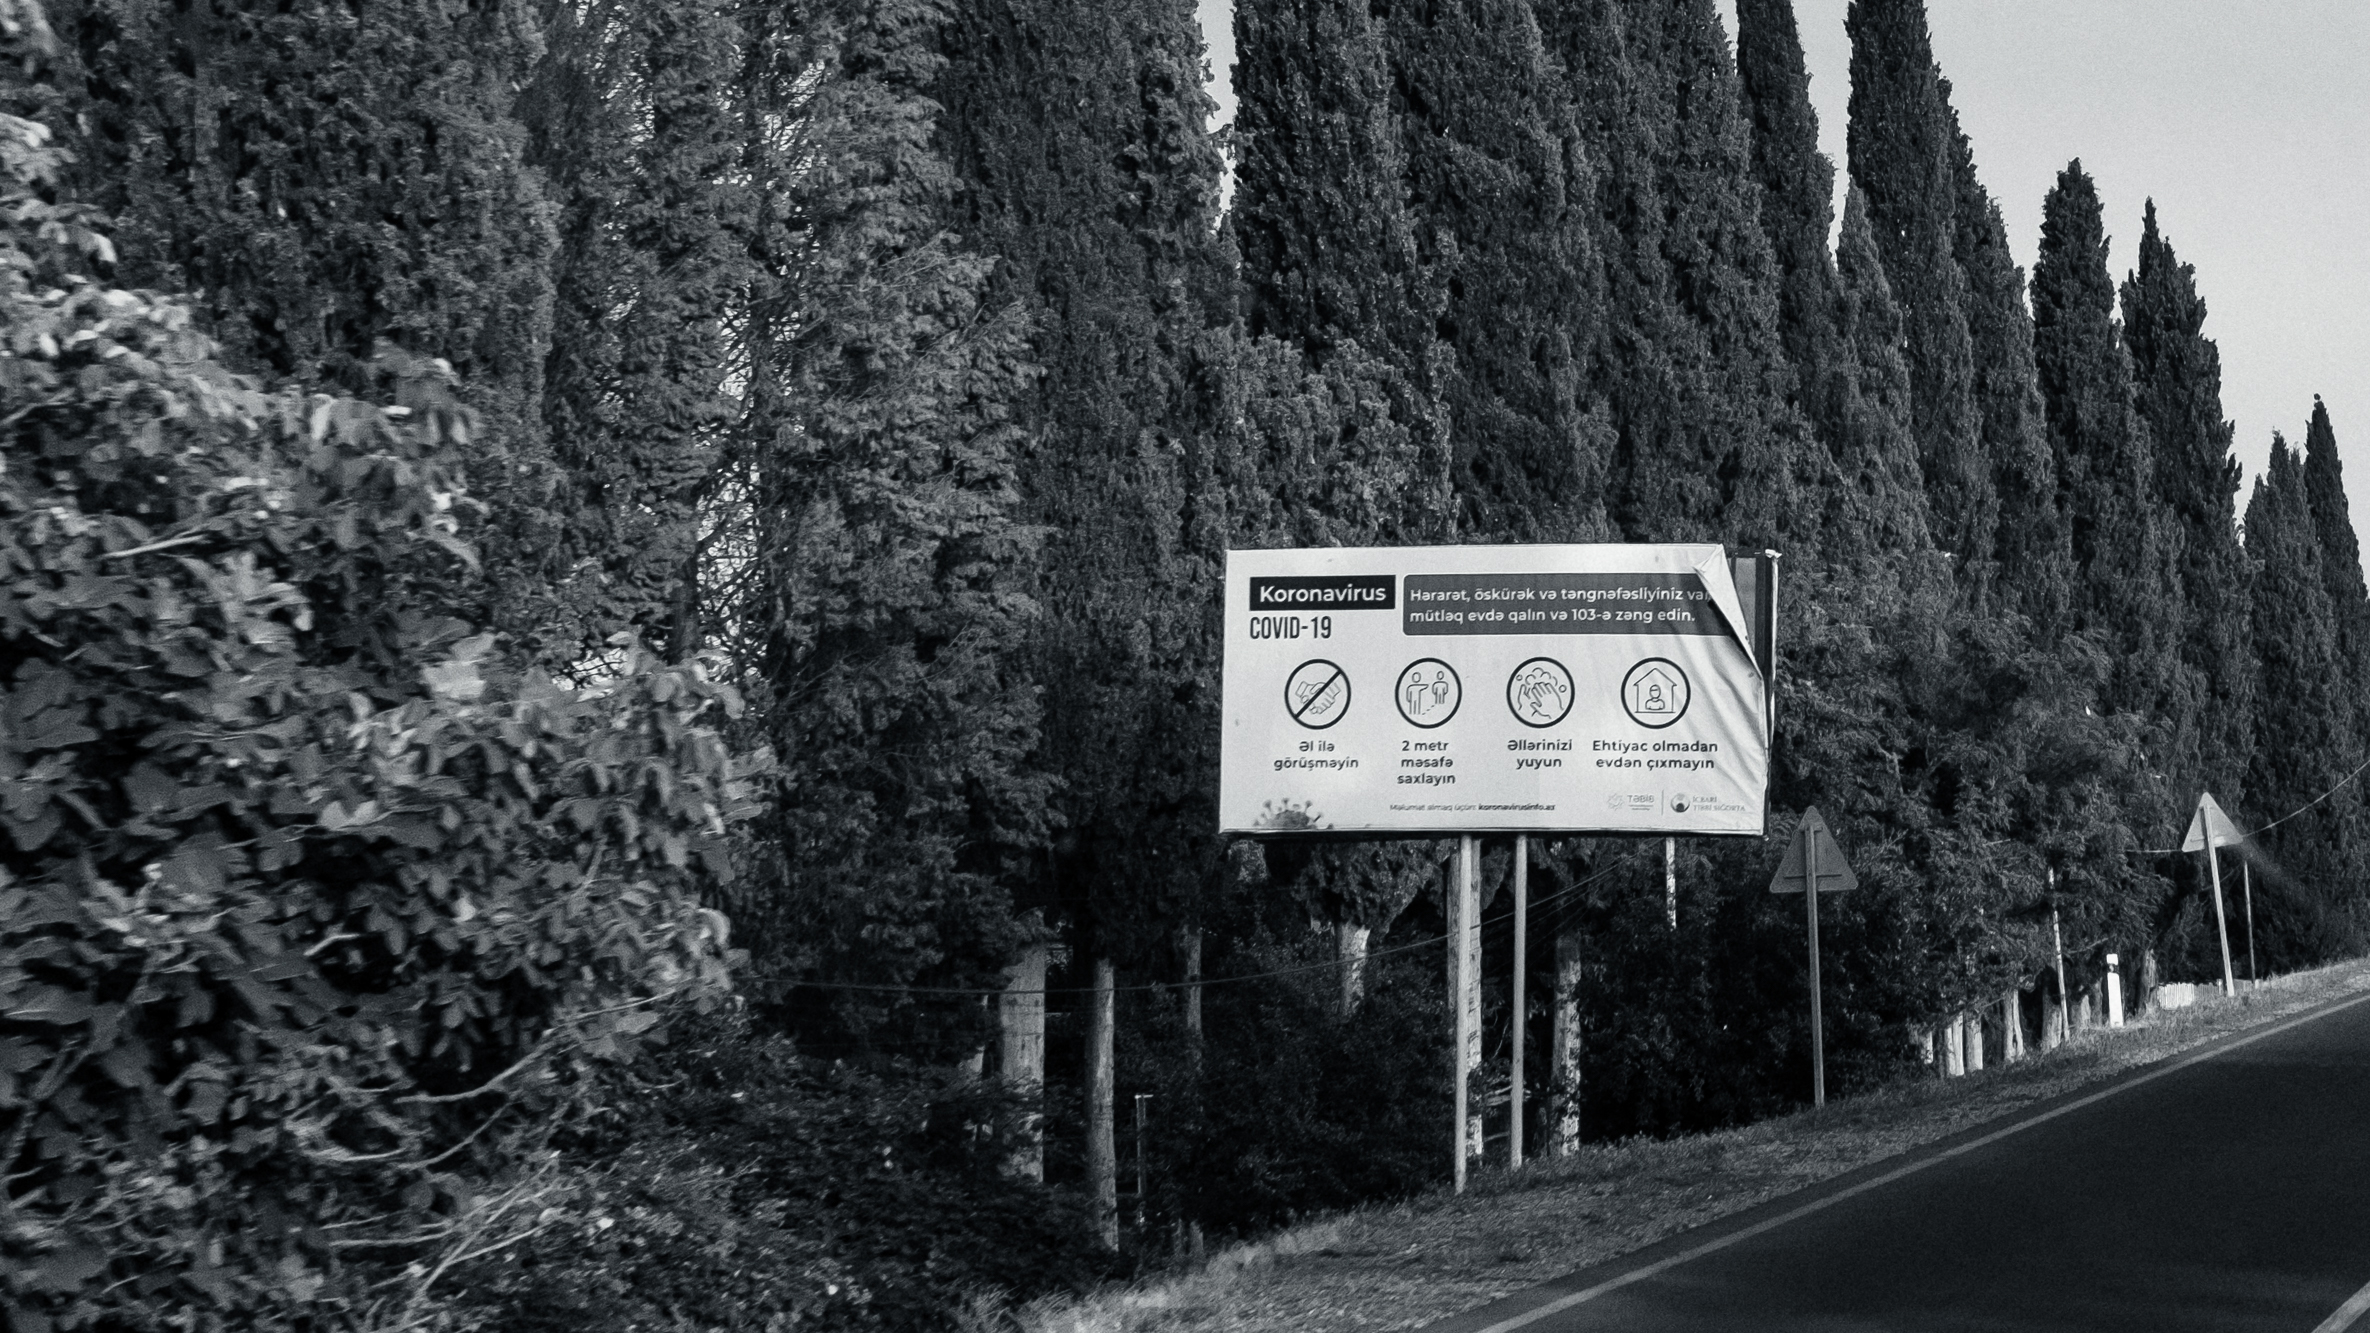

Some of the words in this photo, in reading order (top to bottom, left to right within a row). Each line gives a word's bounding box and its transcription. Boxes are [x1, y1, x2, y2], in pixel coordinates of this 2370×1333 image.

[1260, 584, 1386, 602] Koronavirus
[1539, 590, 1557, 600] və
[1561, 587, 1684, 602] təngnəfəsliyiniz
[1409, 608, 1464, 625] mütləq
[1467, 608, 1504, 621] evdə
[1508, 608, 1546, 624] qalın
[1550, 610, 1568, 621] və
[1572, 608, 1612, 621] 103-ə
[1615, 610, 1653, 624] zəng
[1657, 608, 1696, 622] edin.
[1250, 615, 1332, 640] COVID-19
[1299, 740, 1314, 752] Əl
[1318, 739, 1335, 752] ilə
[1402, 740, 1410, 751] 2
[1414, 740, 1449, 752] metr
[1507, 738, 1573, 751] Əllərinizi
[1592, 740, 1648, 754] Ehtiyac
[1652, 739, 1718, 752] olmadan
[1274, 756, 1359, 772] görüşməyin
[1401, 756, 1454, 768] məsafə
[1516, 757, 1562, 770] yuyun
[1596, 757, 1642, 768] evdən
[1646, 758, 1715, 771] çıxmayın
[1397, 772, 1456, 787] saxlayın
